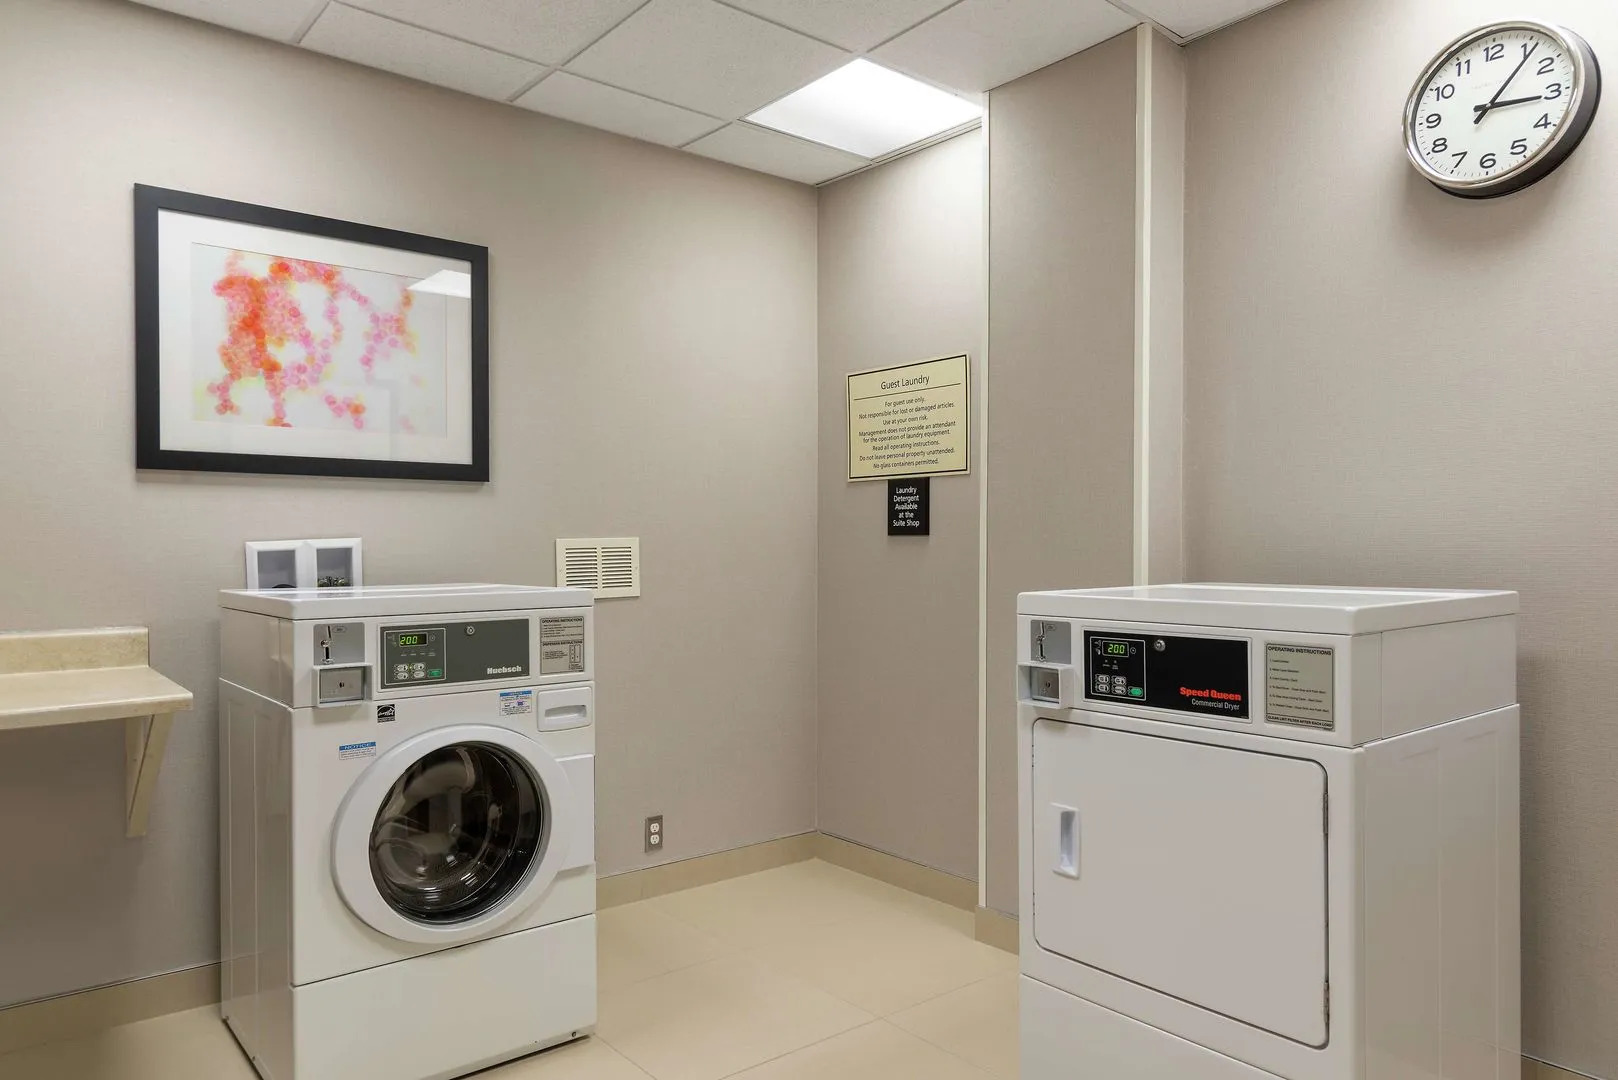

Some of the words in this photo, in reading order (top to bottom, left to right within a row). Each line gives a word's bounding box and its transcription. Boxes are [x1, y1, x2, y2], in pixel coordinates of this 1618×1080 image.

[1484, 44, 1504, 62] 12
[1521, 43, 1528, 60] 1
[1456, 60, 1470, 76] 11
[1537, 57, 1554, 75] 2
[1435, 84, 1454, 101] 10
[1544, 84, 1562, 100] 3
[1426, 114, 1442, 129] 9
[1533, 114, 1551, 129] 4
[1432, 138, 1447, 153] 8
[1510, 138, 1527, 155] 5
[1452, 152, 1468, 168] 7
[1480, 153, 1496, 168] 6
[881, 380, 900, 389] Guest
[902, 375, 929, 386] Laundry
[896, 486, 917, 494] Laundry
[400, 636, 418, 645] 200
[1108, 644, 1125, 654] 200
[487, 665, 521, 674] Huebsch
[1180, 687, 1209, 698] Speed
[1210, 690, 1241, 701] Queen
[1191, 698, 1223, 709] Commercial
[1224, 701, 1239, 710] Dryer
